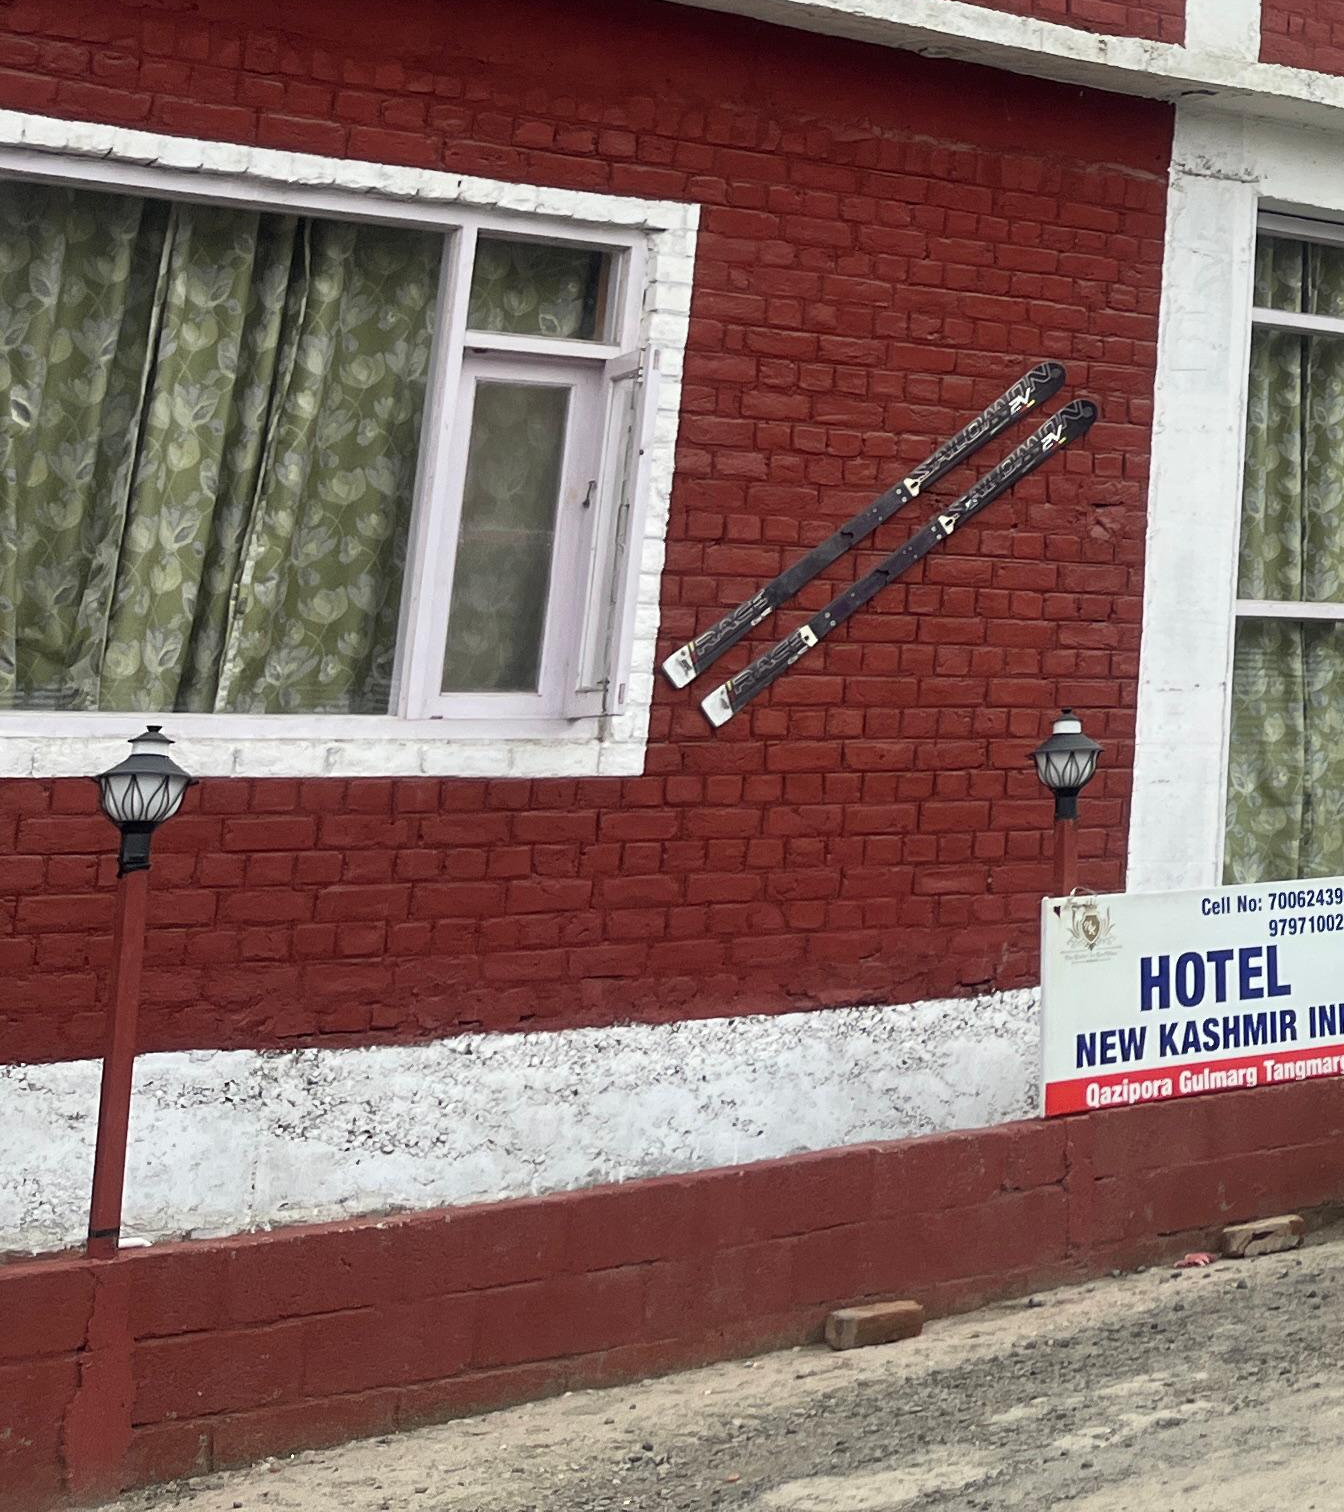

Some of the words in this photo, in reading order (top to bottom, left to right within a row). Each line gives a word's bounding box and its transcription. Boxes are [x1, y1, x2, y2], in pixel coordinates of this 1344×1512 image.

[1201, 897, 1231, 916] Cell
[1237, 895, 1263, 913] No:
[1140, 945, 1292, 1012] HOTEL
[1076, 1026, 1147, 1069] NEW
[1159, 1009, 1298, 1058] KASHMIR
[1085, 1077, 1173, 1108] Qazipora
[1179, 1067, 1258, 1094] Gulmarg
